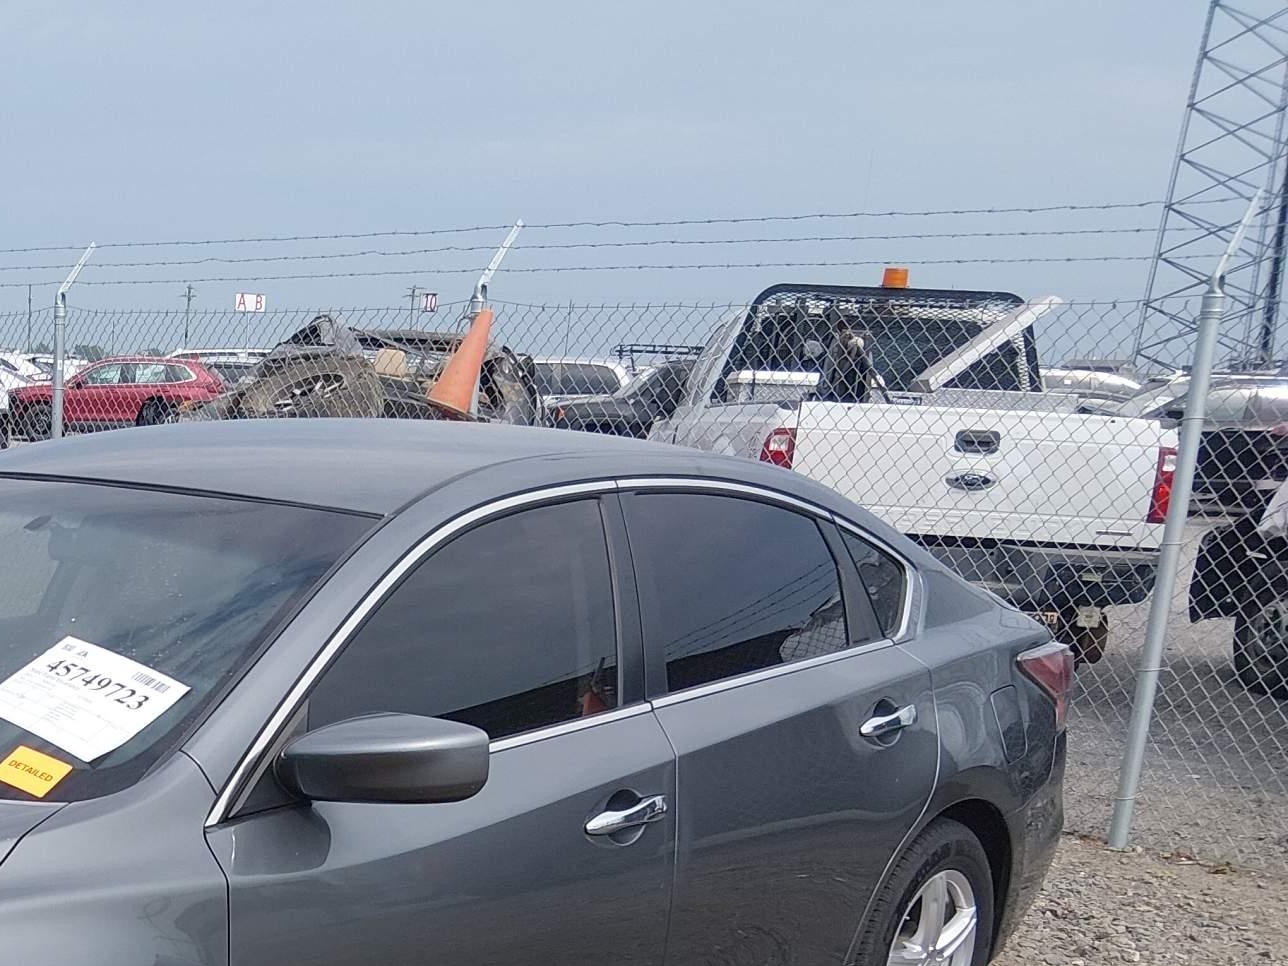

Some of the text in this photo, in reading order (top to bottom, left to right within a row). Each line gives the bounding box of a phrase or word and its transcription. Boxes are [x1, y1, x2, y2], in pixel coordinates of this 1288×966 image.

[237, 293, 263, 311] A B
[46, 659, 150, 711] 45749723
[7, 759, 54, 783] DETAILED
